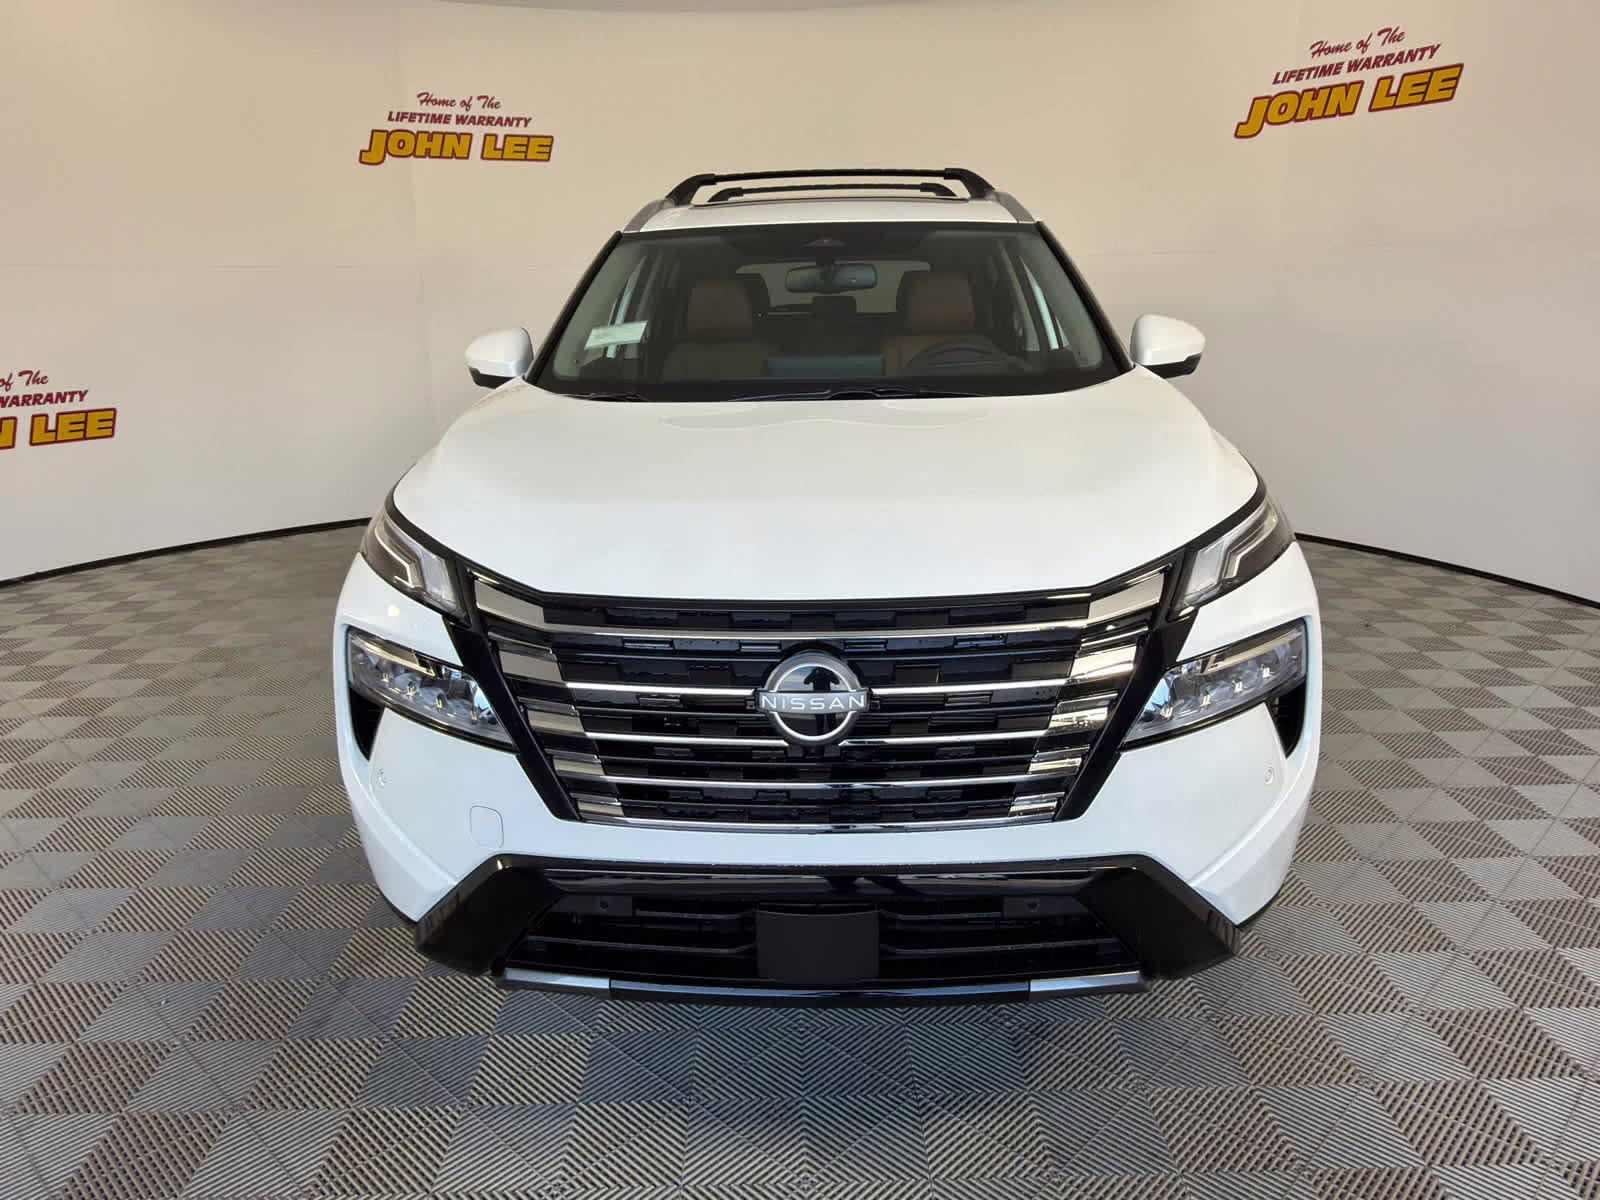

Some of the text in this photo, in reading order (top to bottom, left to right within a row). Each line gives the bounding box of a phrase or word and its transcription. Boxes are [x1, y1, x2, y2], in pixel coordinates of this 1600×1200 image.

[1310, 26, 1405, 58] Home of The
[1272, 44, 1442, 85] LIFETIME WARRANTY
[417, 92, 501, 111] Home of The
[1233, 62, 1464, 139] JOHN LEE
[387, 111, 532, 128] LIFETIME WARRANTY
[359, 129, 554, 166] JOHN LEE
[18, 369, 48, 386] The
[29, 408, 117, 446] LEE
[761, 694, 865, 710] NISSAN
